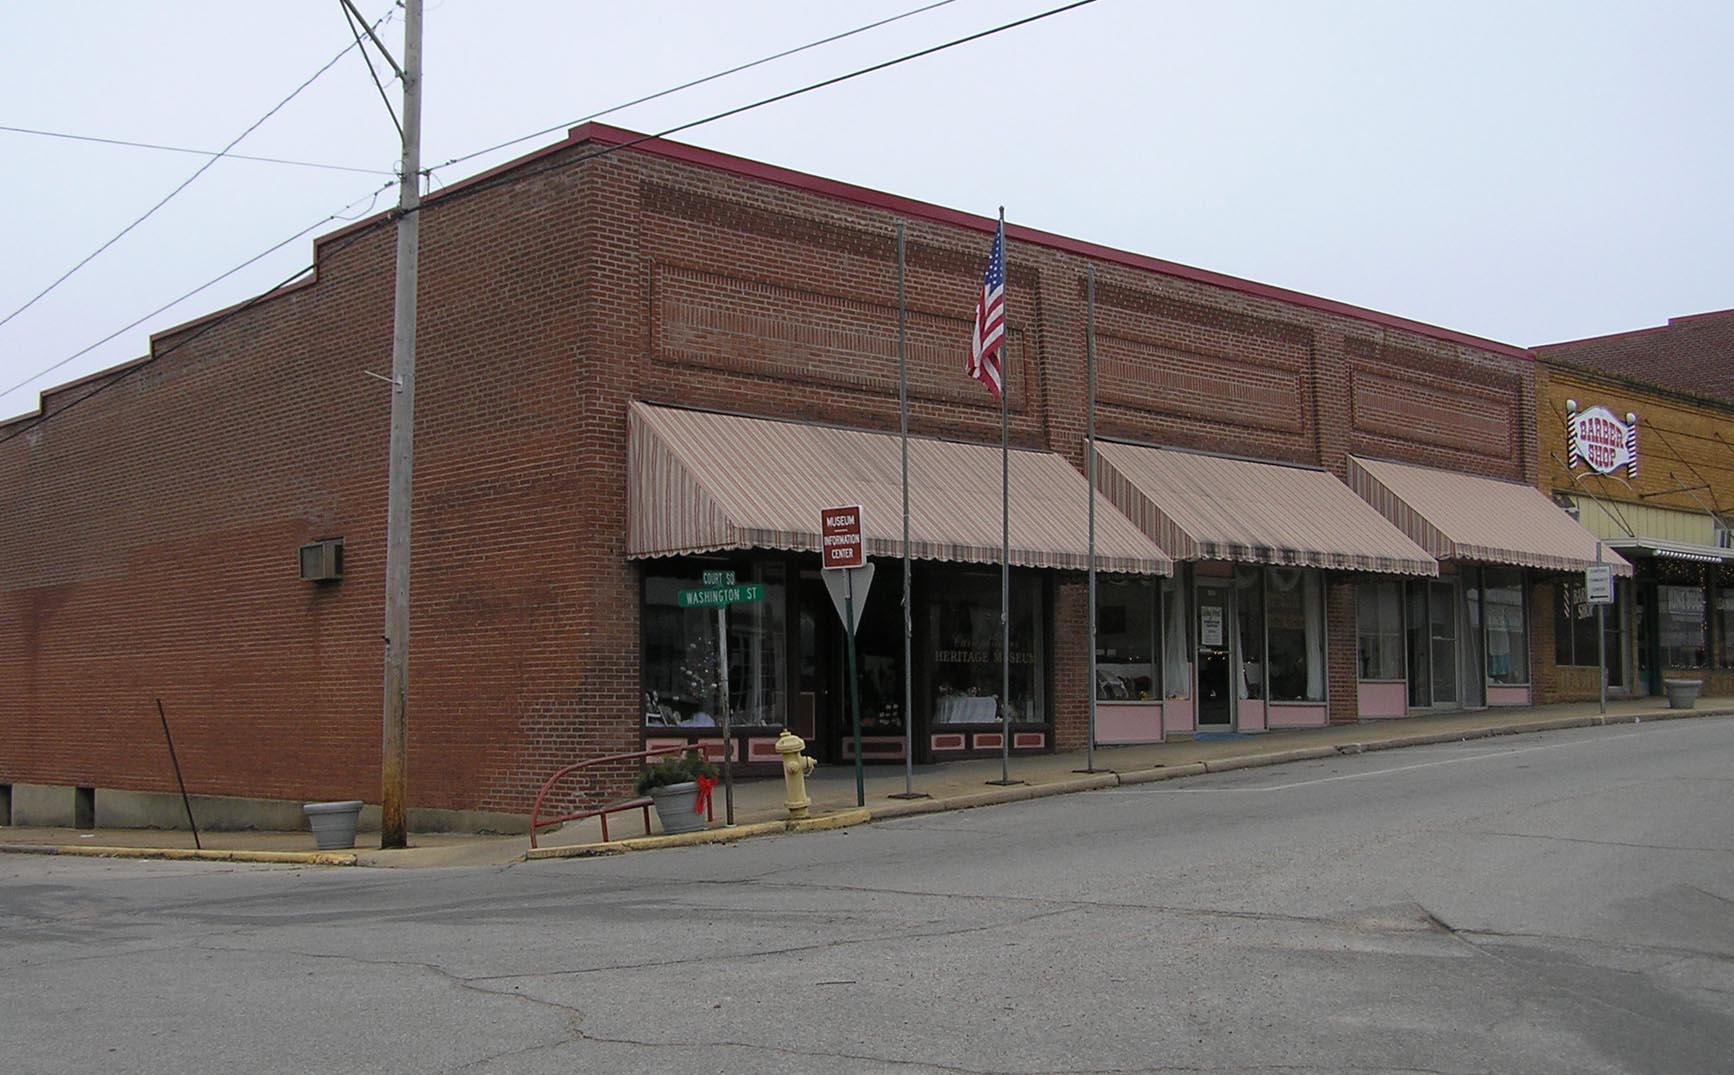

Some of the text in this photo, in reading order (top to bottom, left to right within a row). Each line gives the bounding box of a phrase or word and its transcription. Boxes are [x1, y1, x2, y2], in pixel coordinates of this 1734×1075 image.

[1580, 417, 1624, 449] BARBER
[1588, 443, 1616, 468] SHOP
[826, 515, 855, 527] MUSEUM
[823, 533, 860, 546] INFORMATION
[831, 548, 854, 559] CENTER
[703, 572, 722, 585] COURT
[686, 586, 757, 605] WASHINGTON ST
[935, 650, 1037, 664] HERITAGE MSEU
